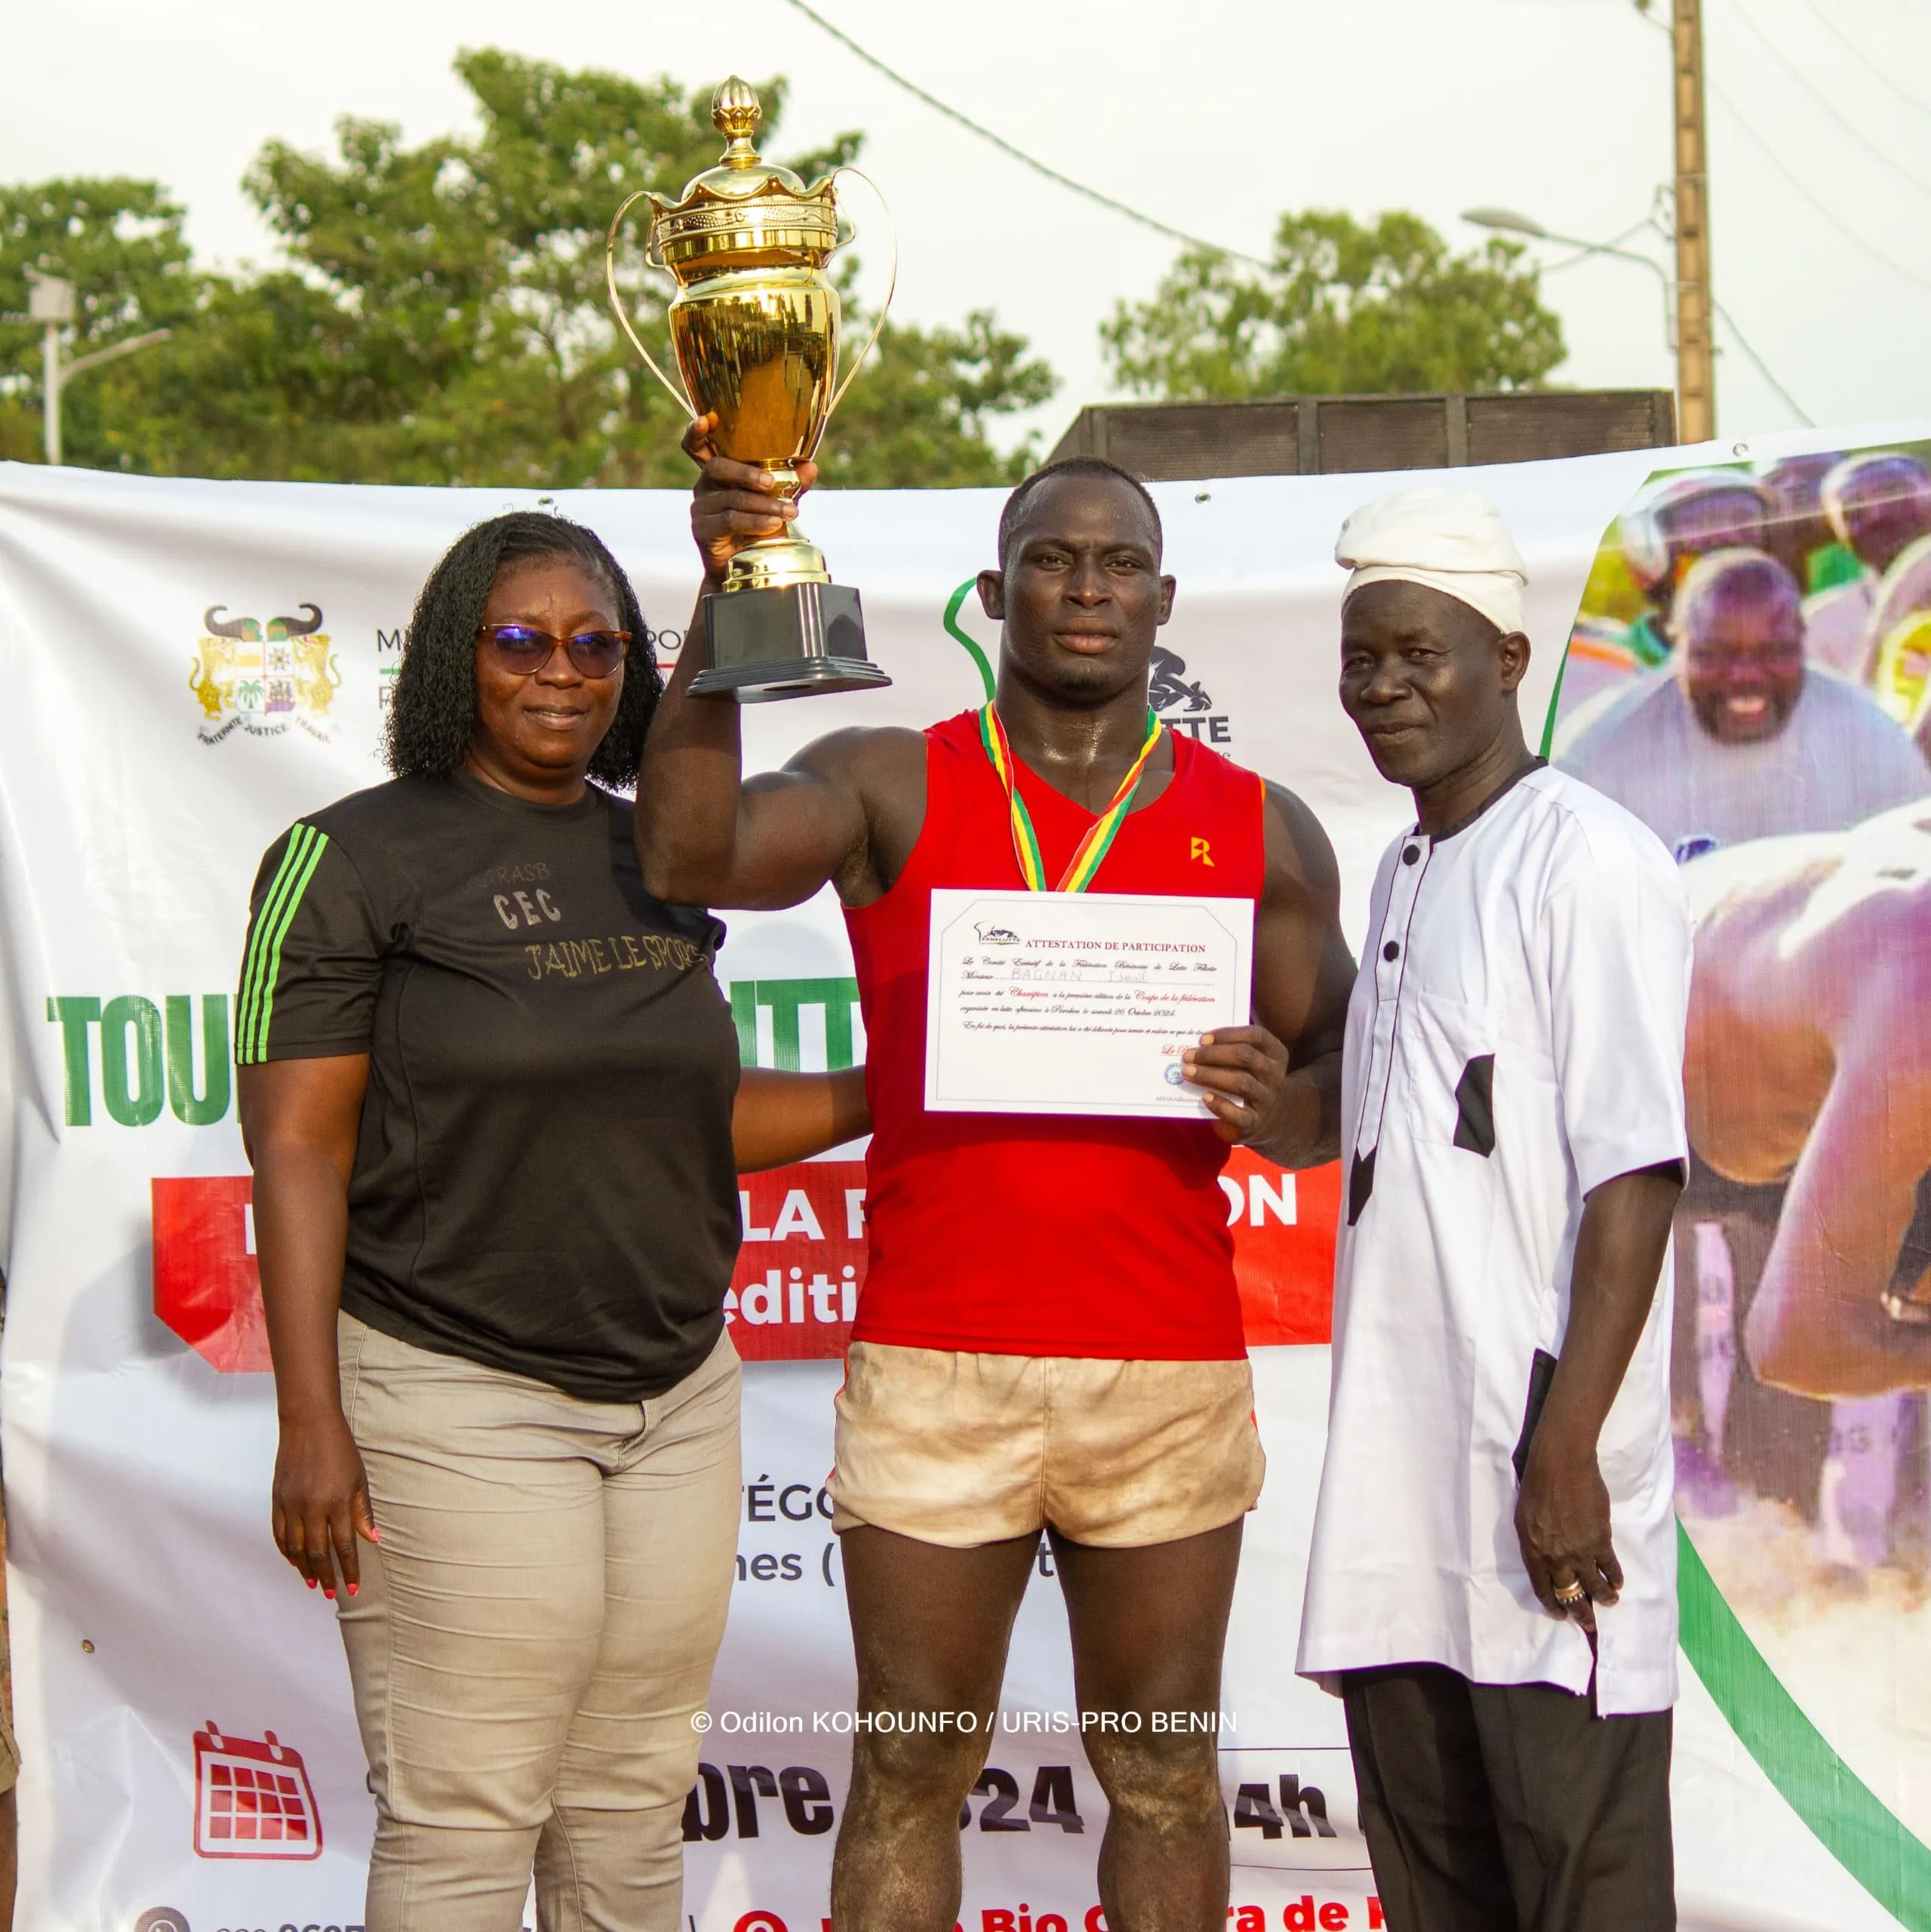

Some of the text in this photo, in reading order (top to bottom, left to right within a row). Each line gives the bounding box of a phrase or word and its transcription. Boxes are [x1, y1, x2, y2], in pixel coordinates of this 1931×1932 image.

[244, 722, 286, 737] JUSTICE
[493, 888, 561, 931] CEC
[607, 935, 647, 970] LE
[1025, 939, 1206, 954] ATTESTATION DE PARTICIPATION
[962, 956, 973, 965] Le
[961, 971, 994, 980] Monsieur
[1011, 968, 1083, 982] BAGNAN
[958, 989, 974, 998] pour
[1008, 986, 1049, 1000] Champion
[1133, 990, 1159, 1004] Coupe
[1160, 993, 1170, 1001] de
[1170, 993, 1179, 1001] la
[1177, 992, 1216, 1006] fédération
[1090, 1008, 1113, 1016] samedi
[1114, 1008, 1125, 1016] 26
[1127, 1007, 1152, 1017] Octobre
[963, 1021, 976, 1030] En
[1283, 1895, 1349, 1932] de
